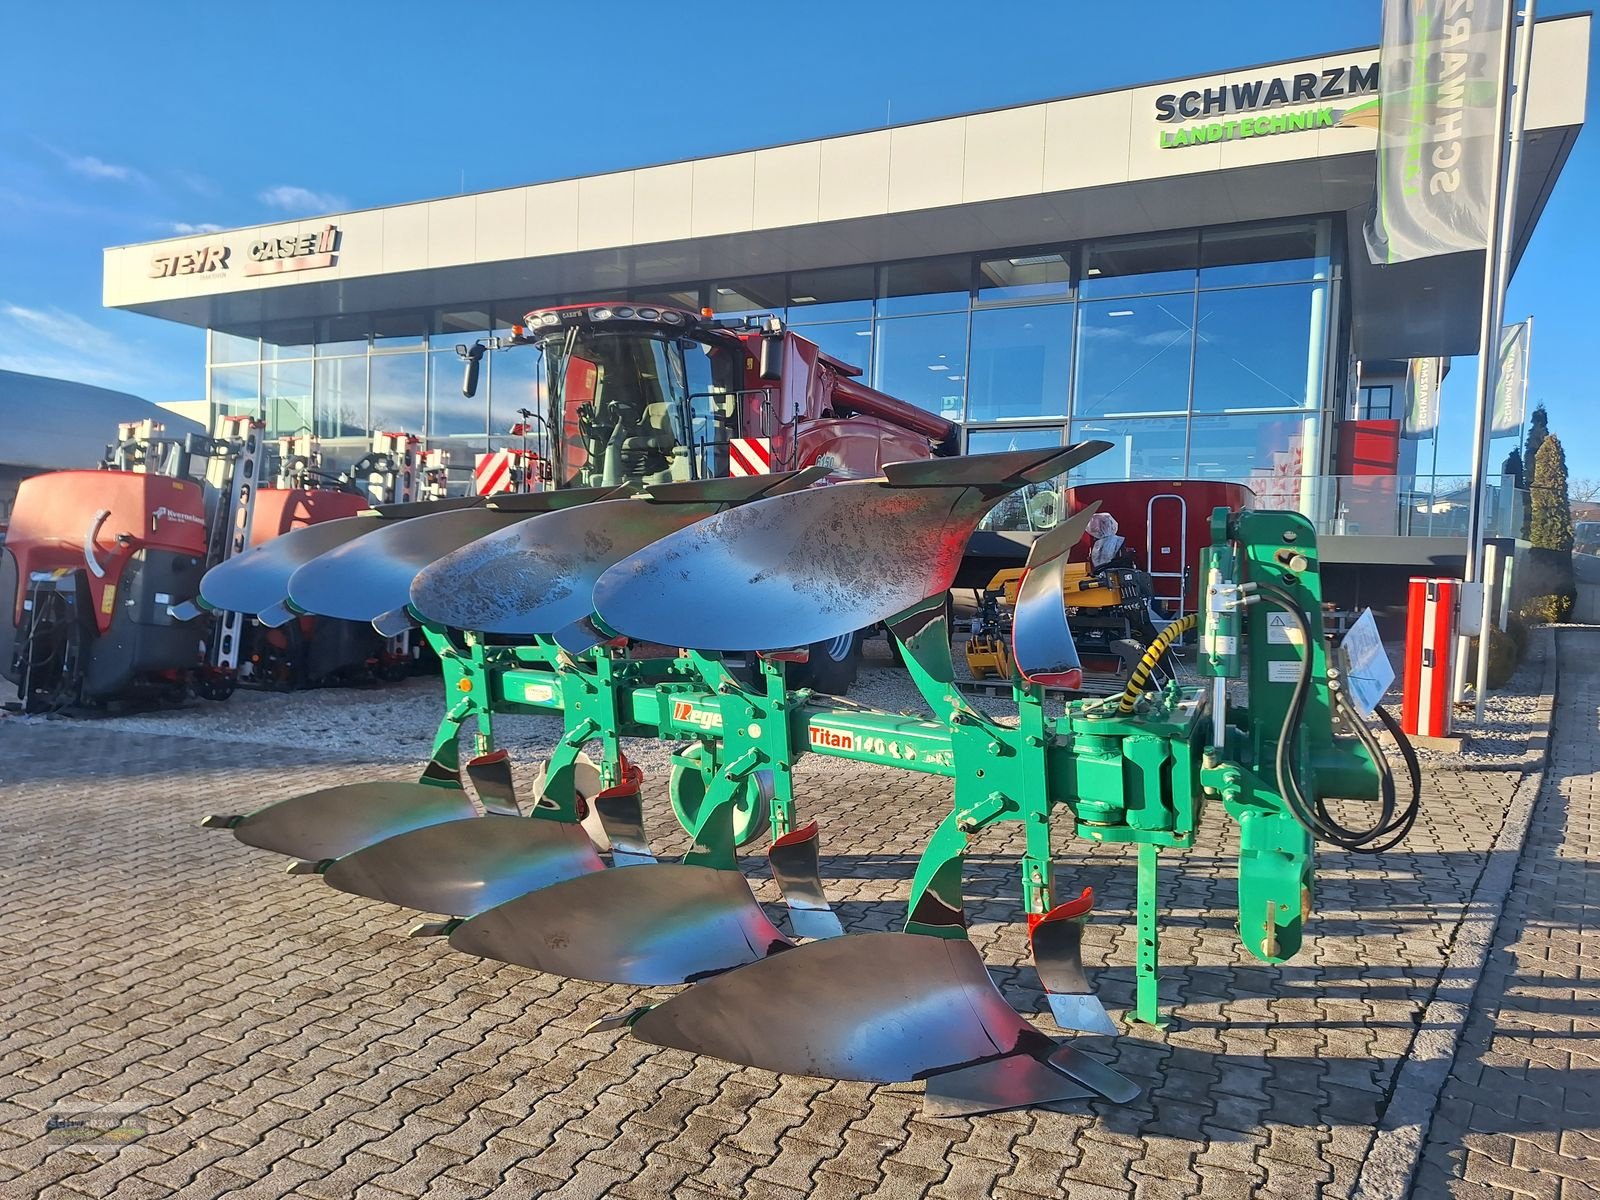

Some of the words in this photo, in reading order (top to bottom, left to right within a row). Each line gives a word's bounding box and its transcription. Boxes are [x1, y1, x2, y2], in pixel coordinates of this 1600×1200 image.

[1160, 107, 1334, 149] LANDTECHNIK
[149, 246, 230, 278] STEYR
[247, 232, 315, 262] CASE
[809, 727, 852, 749] Titan
